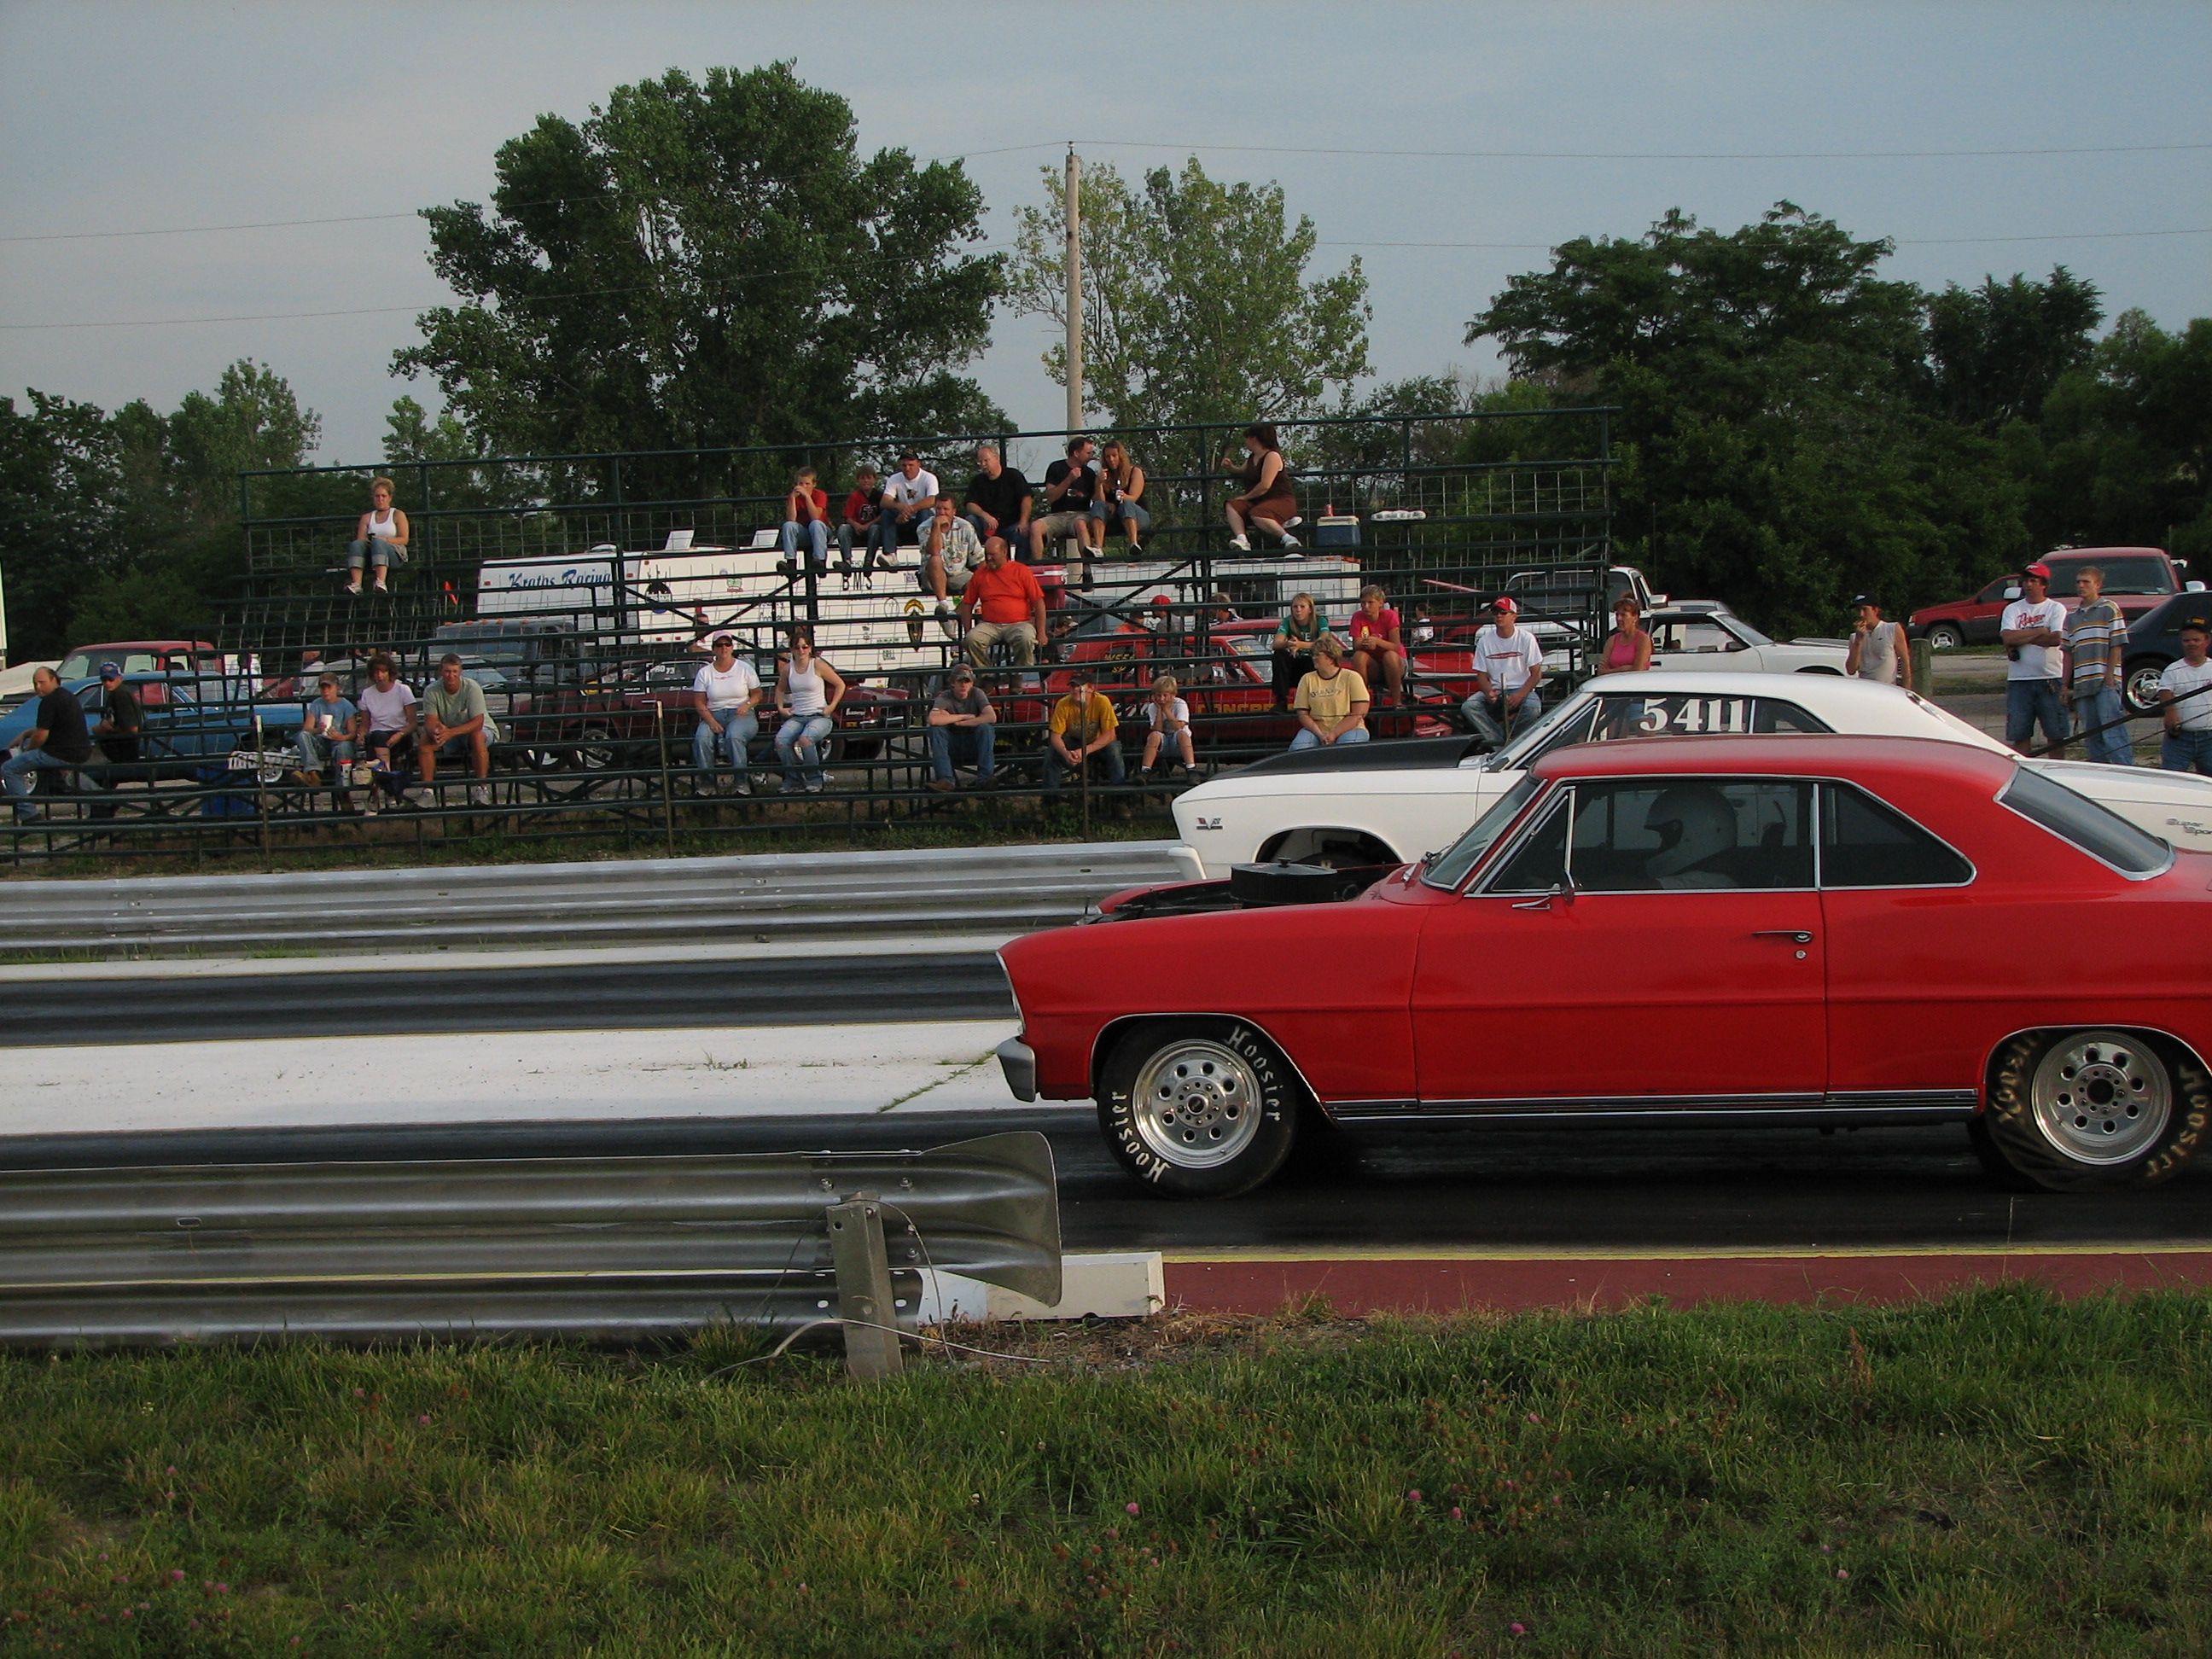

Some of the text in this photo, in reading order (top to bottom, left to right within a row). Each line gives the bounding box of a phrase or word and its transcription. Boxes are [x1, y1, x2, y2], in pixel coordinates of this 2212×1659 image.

[562, 569, 610, 590] Racing
[1639, 698, 1744, 732] 5411
[1224, 1025, 1284, 1121] Hoosier
[1110, 1091, 1172, 1183] Hoosier
